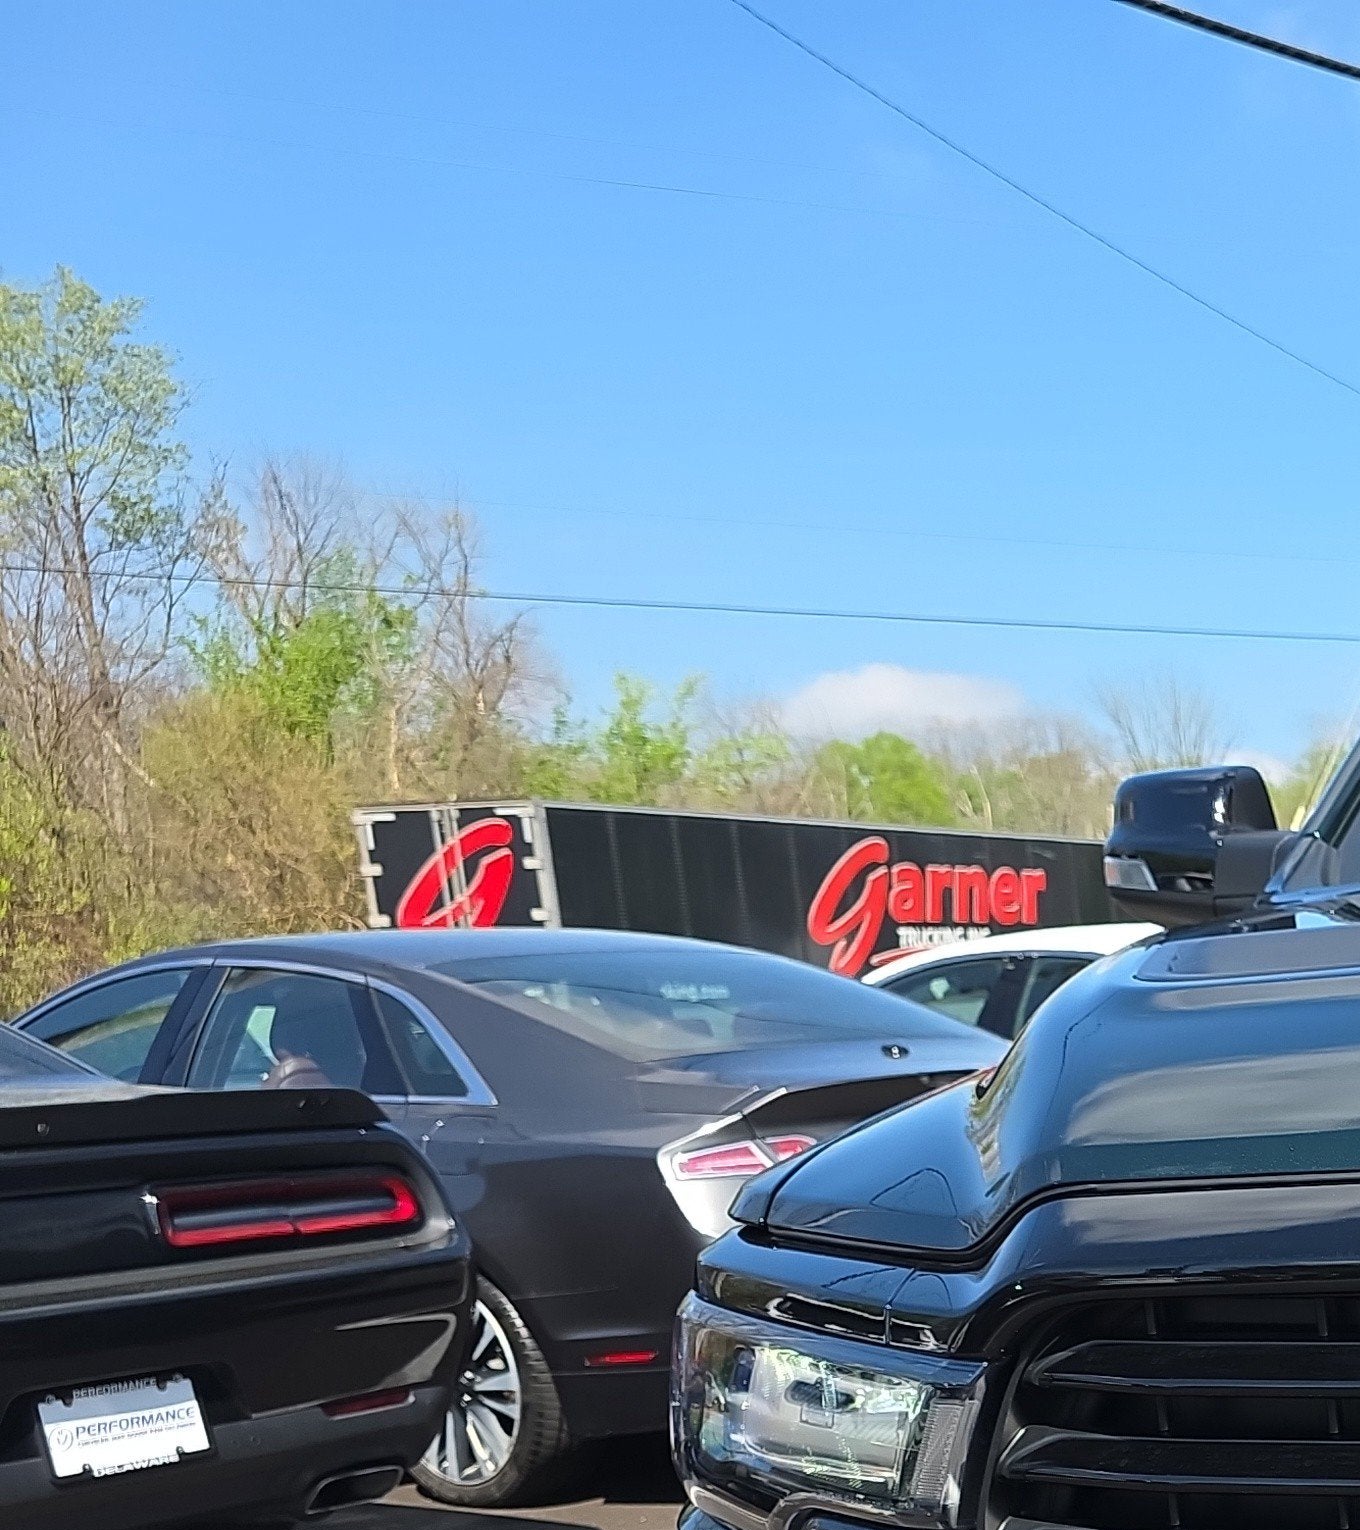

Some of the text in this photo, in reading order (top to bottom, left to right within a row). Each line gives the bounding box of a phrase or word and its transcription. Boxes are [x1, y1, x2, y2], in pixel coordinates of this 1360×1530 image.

[807, 836, 1047, 978] Garner
[73, 1376, 157, 1398] PERFORMANCE
[75, 1406, 196, 1439] PERFORMANCE
[95, 1454, 180, 1477] DELAWARE
